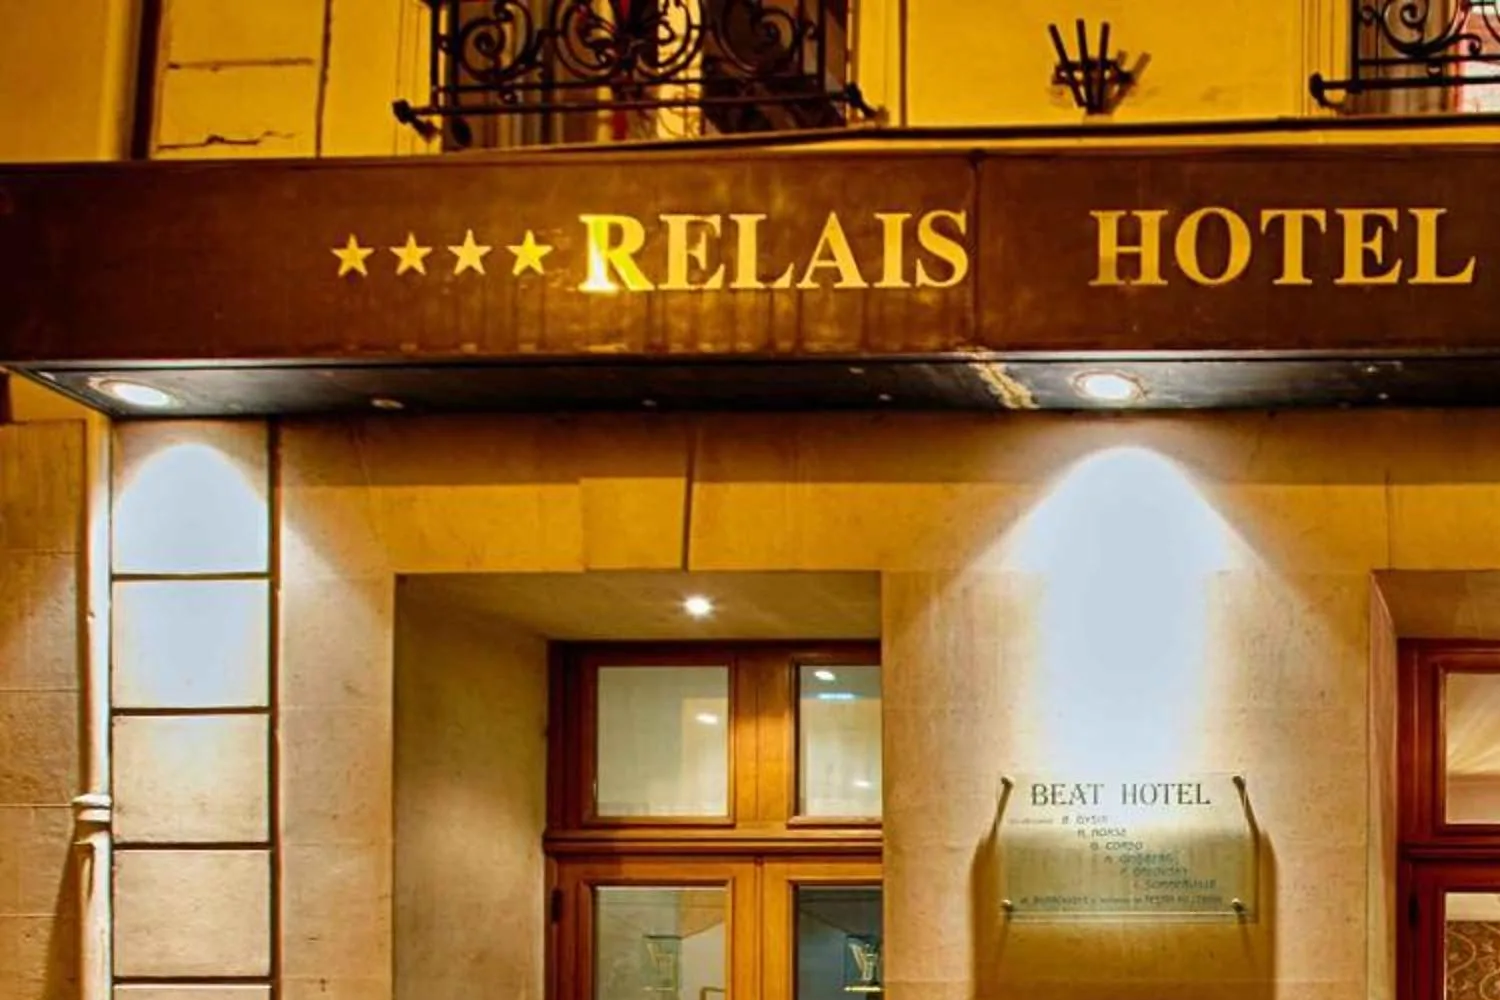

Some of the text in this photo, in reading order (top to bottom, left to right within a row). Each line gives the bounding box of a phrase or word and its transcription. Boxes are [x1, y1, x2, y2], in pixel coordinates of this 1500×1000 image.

[577, 208, 970, 292] RELAIS
[1088, 205, 1477, 287] HOTEL
[1030, 783, 1212, 806] BEAT HOTEL
